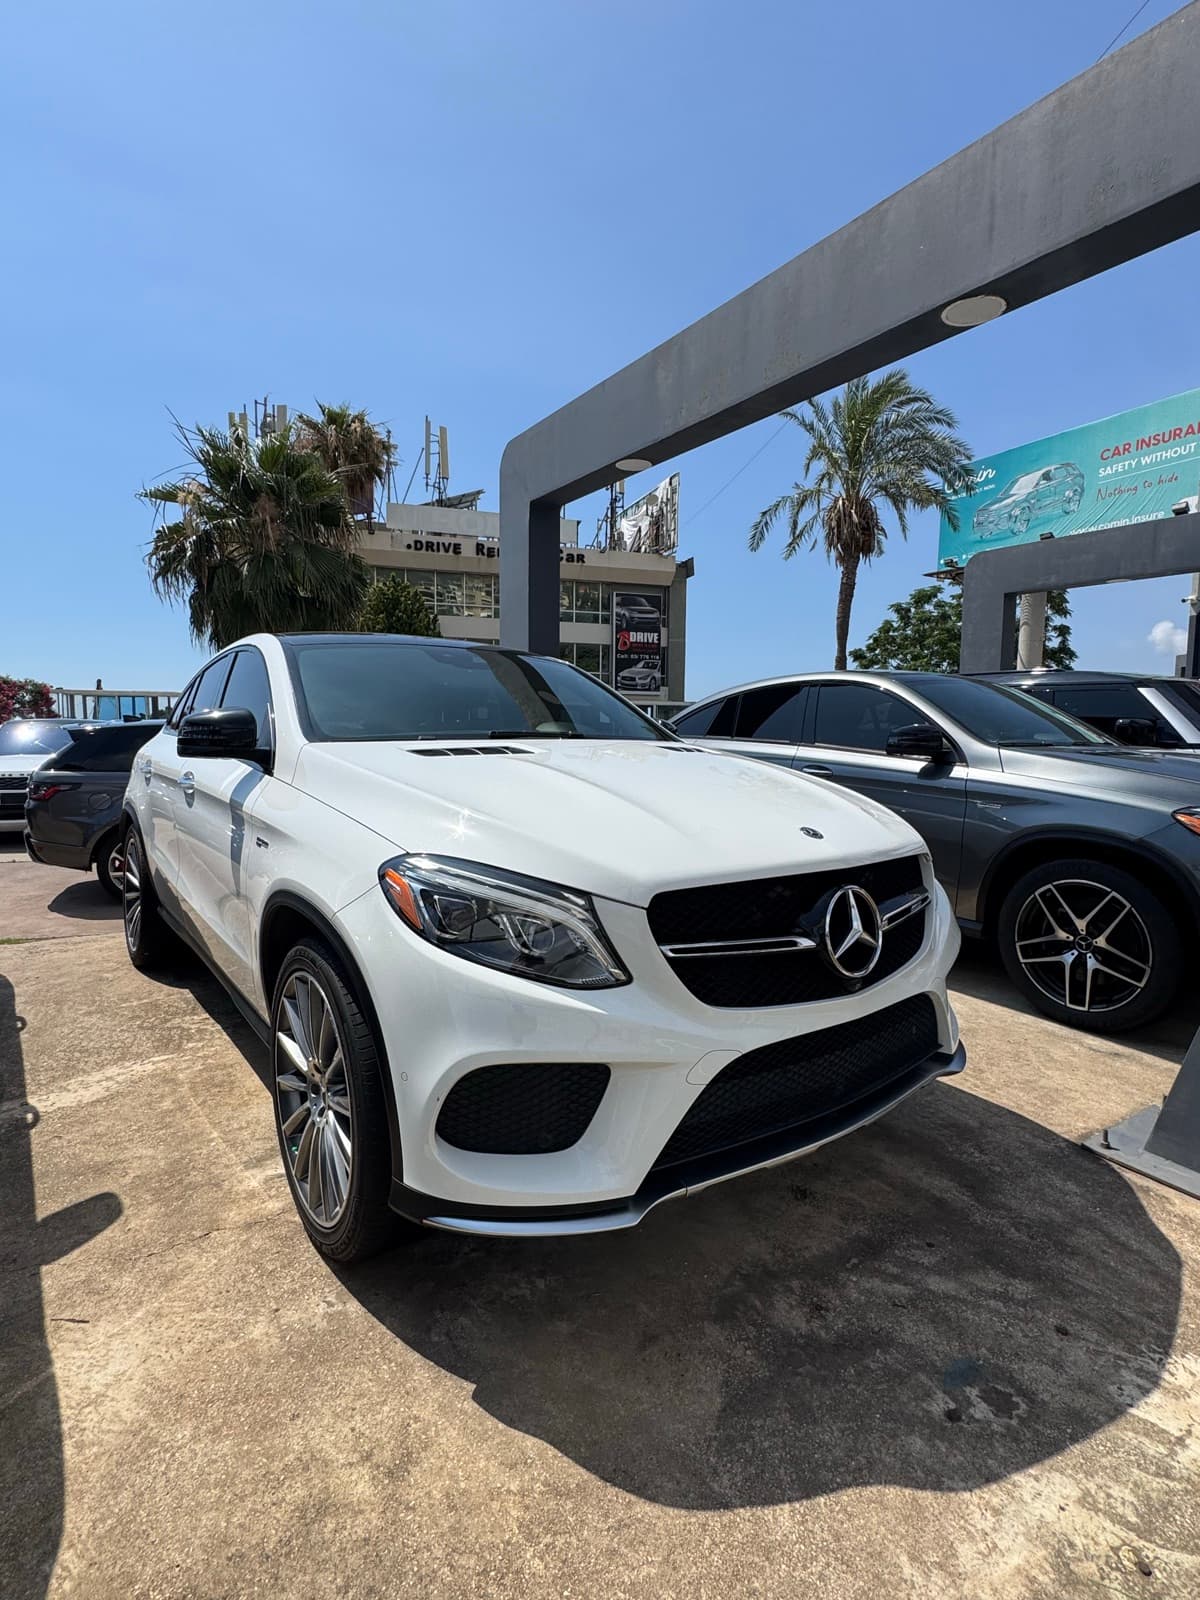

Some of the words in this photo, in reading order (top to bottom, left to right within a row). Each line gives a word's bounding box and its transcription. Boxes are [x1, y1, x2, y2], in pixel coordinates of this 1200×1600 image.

[1098, 458, 1138, 477] SAFETY
[1140, 442, 1198, 466] WITHOUT
[1101, 442, 1131, 461] CAR
[1096, 484, 1138, 502] Nothing
[1143, 480, 1153, 489] to
[1158, 471, 1179, 486] hide
[413, 539, 462, 555] DRIVE
[476, 542, 500, 558] RE
